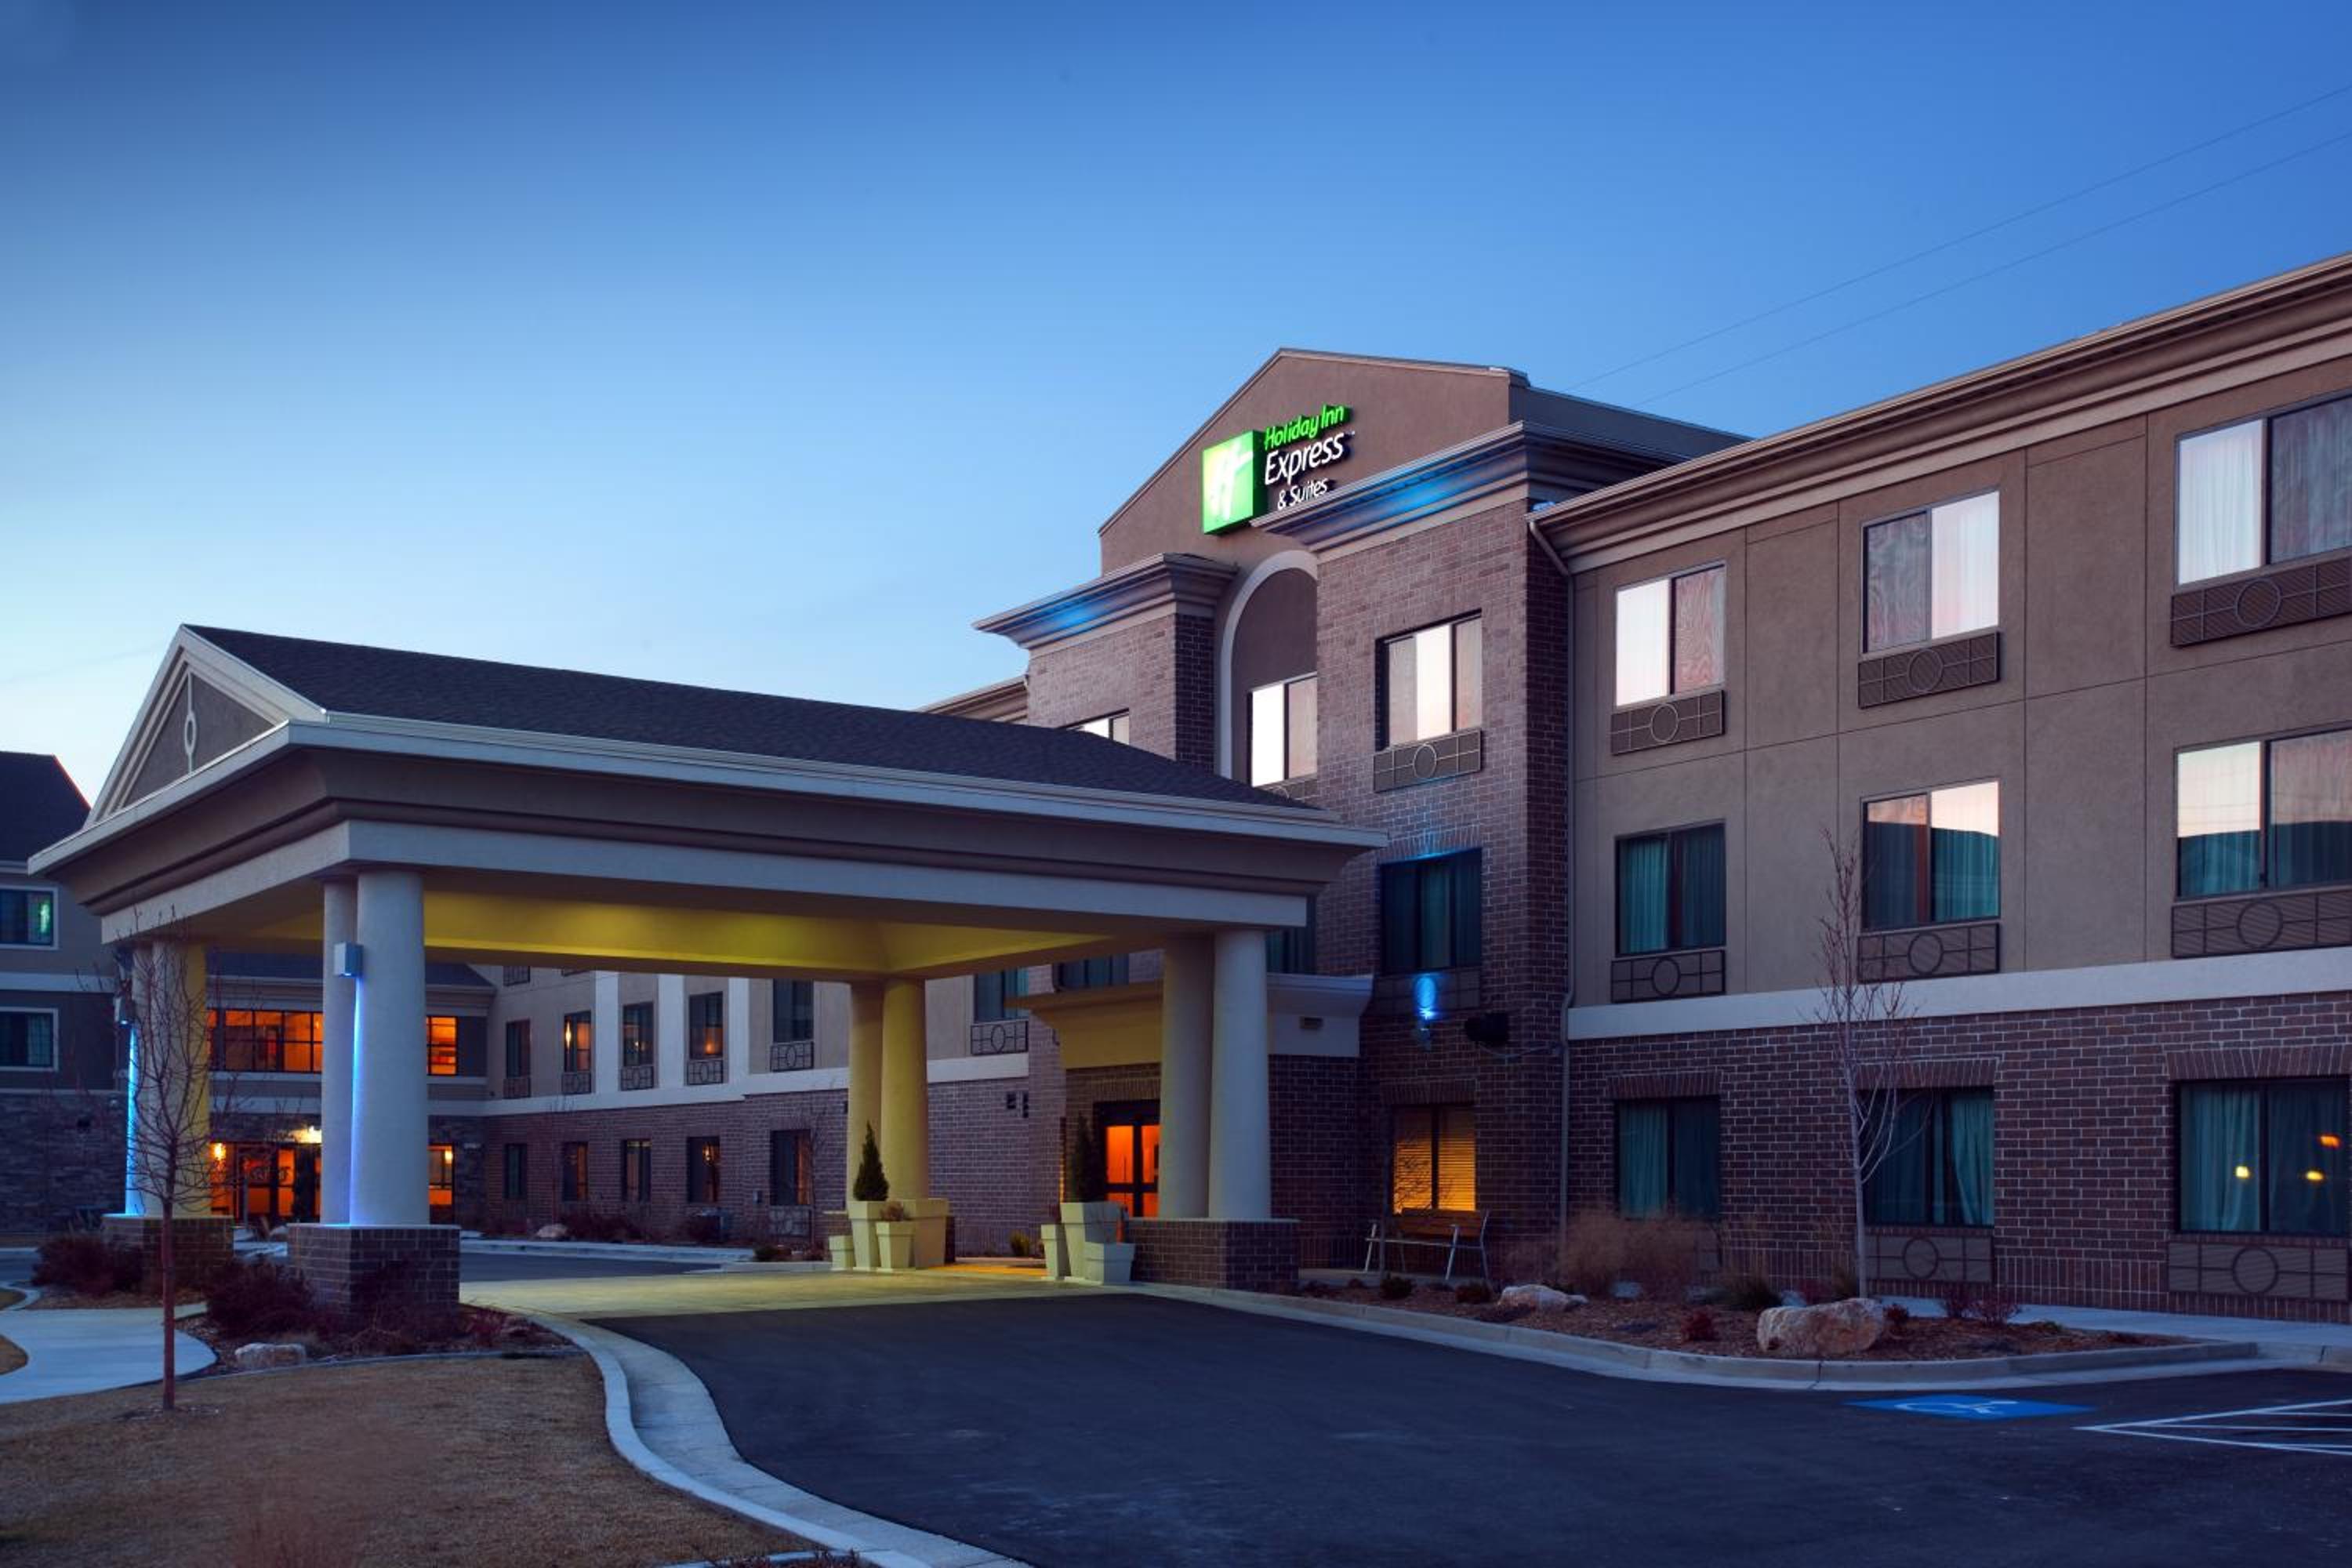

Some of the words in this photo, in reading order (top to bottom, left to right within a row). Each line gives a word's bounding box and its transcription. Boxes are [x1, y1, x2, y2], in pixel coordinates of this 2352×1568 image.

[1265, 414, 1319, 449] Holiday
[1321, 405, 1344, 429] Inn
[1265, 433, 1344, 485] Express
[1277, 489, 1287, 511] &
[1288, 477, 1328, 506] Suites
